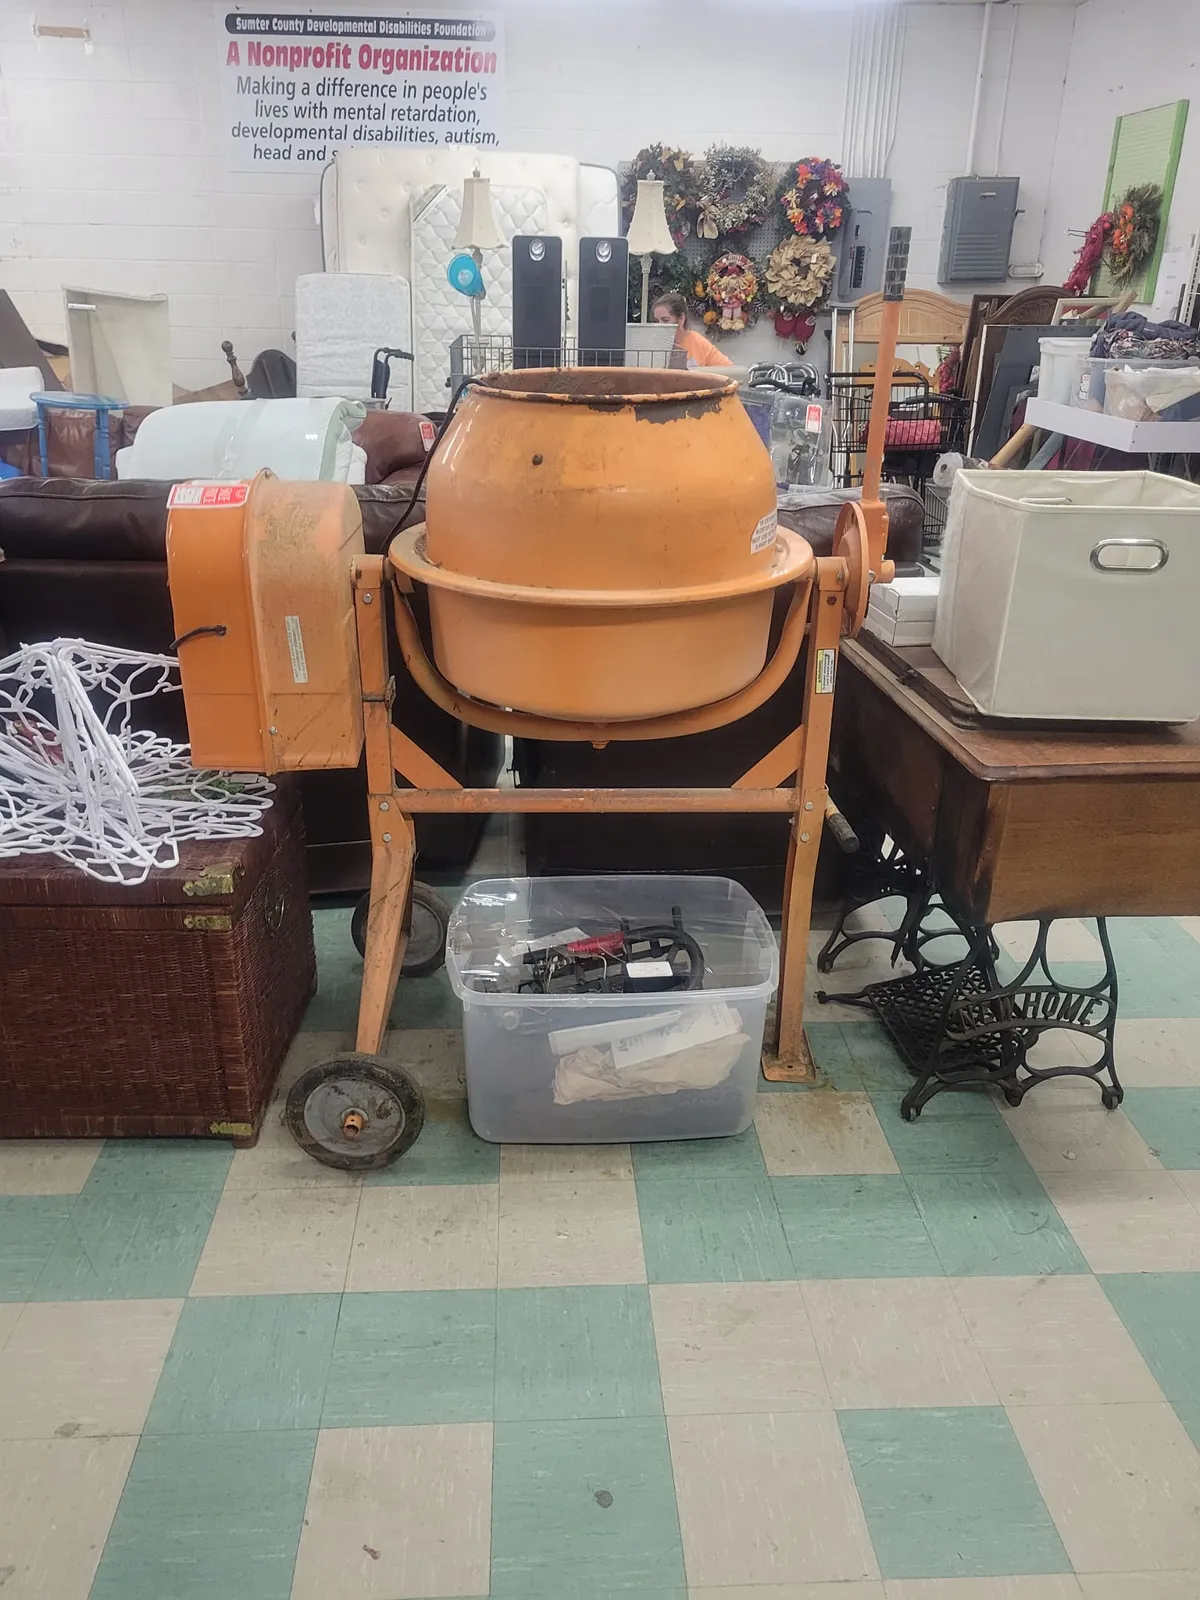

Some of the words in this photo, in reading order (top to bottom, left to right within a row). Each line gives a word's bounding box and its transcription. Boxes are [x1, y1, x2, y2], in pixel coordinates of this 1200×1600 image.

[236, 17, 270, 31] Sumter
[272, 18, 304, 33] County
[307, 19, 377, 34] Developmental
[379, 20, 432, 35] Disabilities
[434, 22, 487, 37] Foundation
[226, 41, 241, 67] A
[247, 41, 352, 72] Nonprofit
[358, 44, 497, 75] Organization
[236, 76, 296, 100] Making
[301, 82, 310, 96] a
[316, 77, 397, 98] difference
[402, 80, 417, 99] in
[422, 81, 487, 104] people's
[255, 100, 288, 119] lives
[294, 101, 328, 120] with
[333, 103, 385, 121] mental
[391, 104, 480, 125] retardation,
[231, 121, 347, 142] developmental
[352, 125, 438, 145] disabilities,
[444, 129, 500, 147] autism,
[253, 143, 291, 160] head
[296, 145, 326, 161] and
[1024, 991, 1103, 1027] HOME
